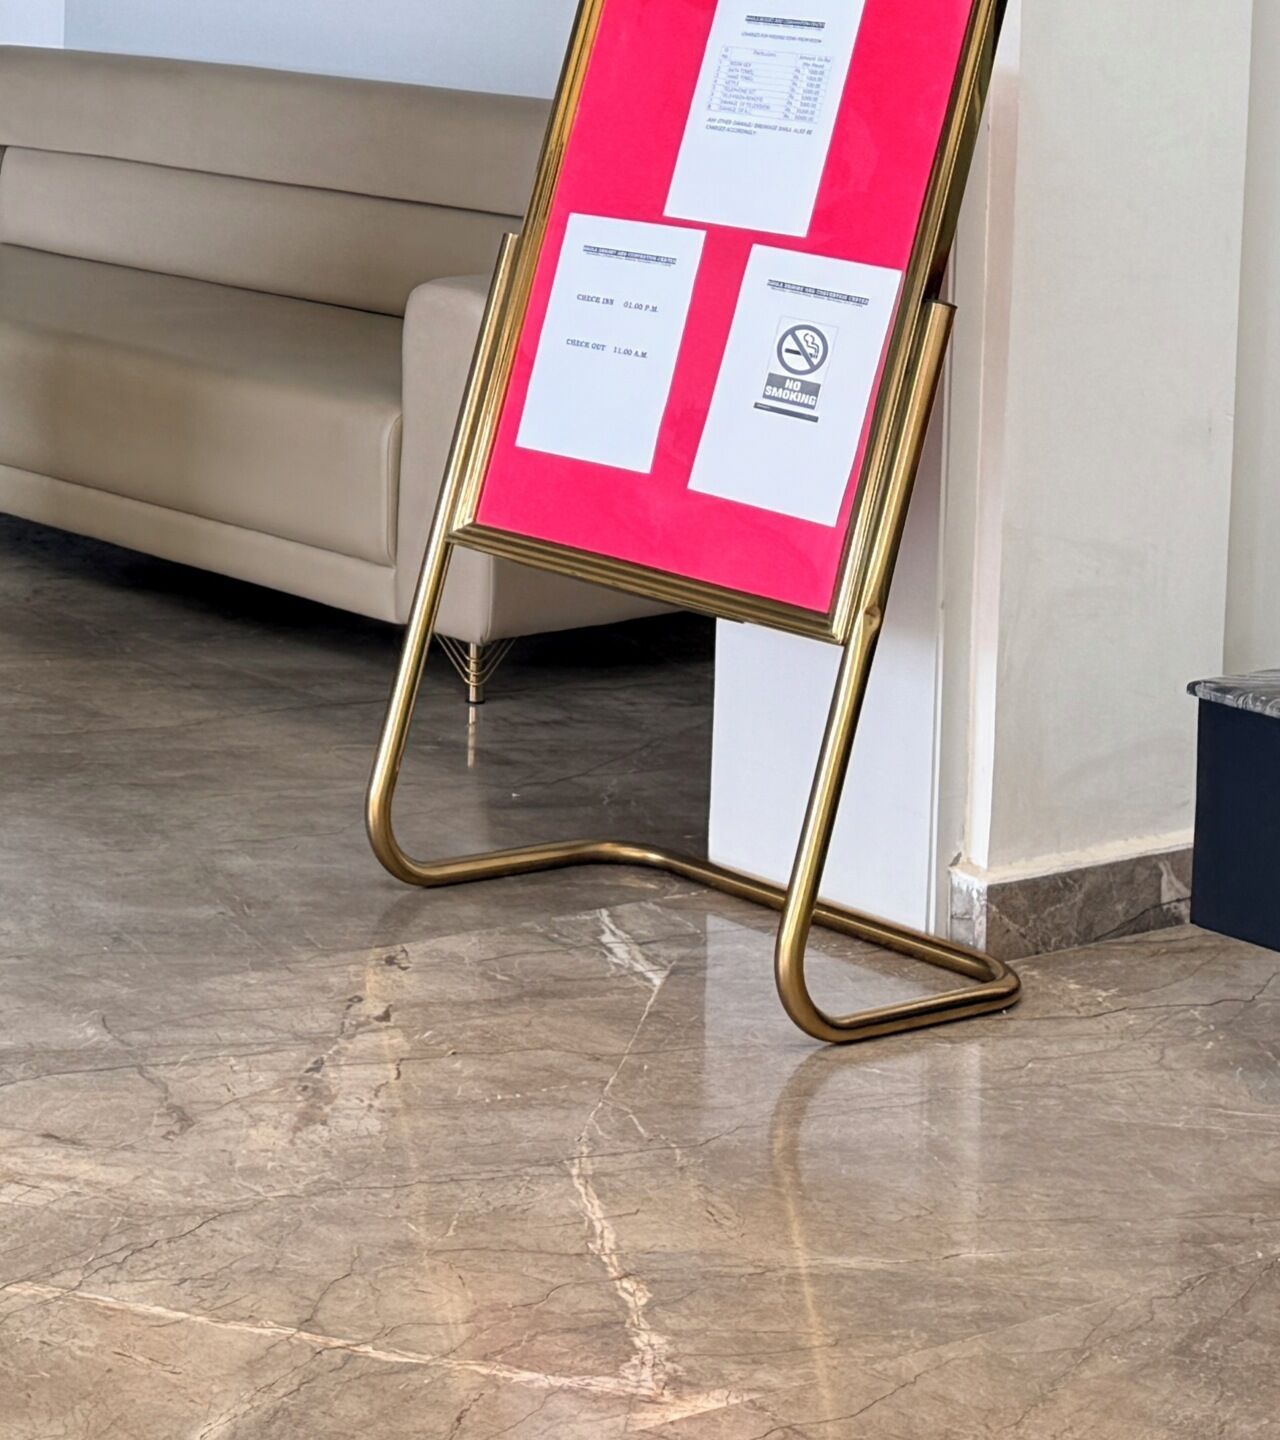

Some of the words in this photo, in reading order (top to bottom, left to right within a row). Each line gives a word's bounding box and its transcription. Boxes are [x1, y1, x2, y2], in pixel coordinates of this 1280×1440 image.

[566, 338, 590, 349] CHECK
[591, 342, 606, 351] OUT
[613, 346, 633, 356] 11.00
[784, 378, 802, 391] NO
[765, 385, 817, 406] SMOKING
